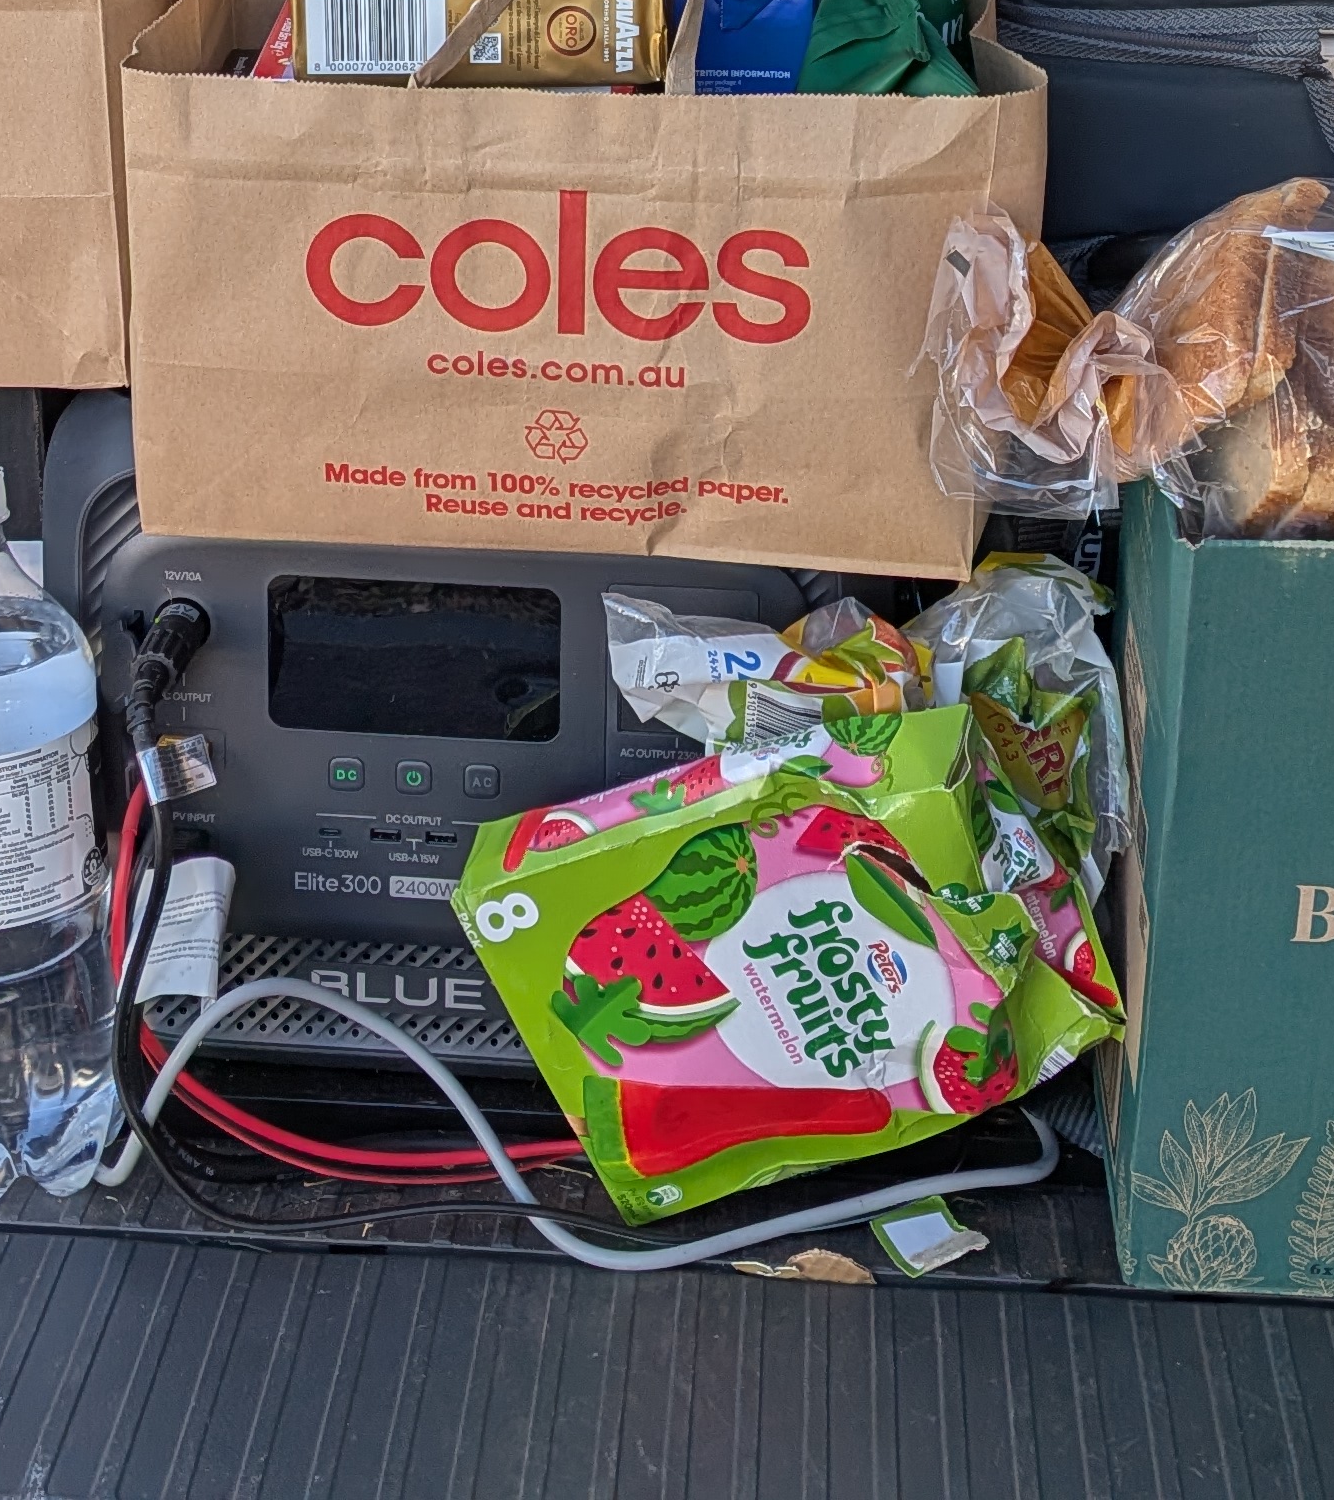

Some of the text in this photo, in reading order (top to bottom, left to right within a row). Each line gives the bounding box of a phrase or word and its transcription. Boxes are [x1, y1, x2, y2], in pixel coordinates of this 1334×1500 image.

[564, 14, 577, 51] ORO
[314, 63, 321, 72] 8
[330, 63, 374, 73] 000070
[695, 70, 791, 78] TRITION INFORMATION
[305, 190, 811, 344] coles
[426, 351, 685, 388] coles.com.au
[325, 463, 789, 504] Made from 100% recycled paper.
[425, 493, 687, 525] Reuse and recycle.
[164, 570, 201, 582] 12V/10A
[172, 692, 212, 703] OUTPUT
[620, 748, 635, 758] AC
[636, 749, 675, 760] OUTPUT
[336, 770, 357, 781] DC
[472, 777, 492, 788] AC
[173, 812, 215, 823] PV INPUT
[386, 814, 442, 826] DC OUTPUT
[302, 848, 358, 859] USB-C 100W
[389, 852, 440, 864] USB-A 15W
[475, 892, 539, 943] 8
[457, 911, 483, 950] PACK
[994, 942, 1012, 962] FREE
[998, 932, 1017, 958] GLUTEN
[788, 899, 896, 1054] frosty
[866, 939, 902, 995] Peters
[311, 970, 487, 1011] BLUE
[742, 932, 862, 1078] fruits
[742, 962, 803, 1065] watermelon
[1310, 1264, 1321, 1277] 6
[1324, 1267, 1334, 1277] x
